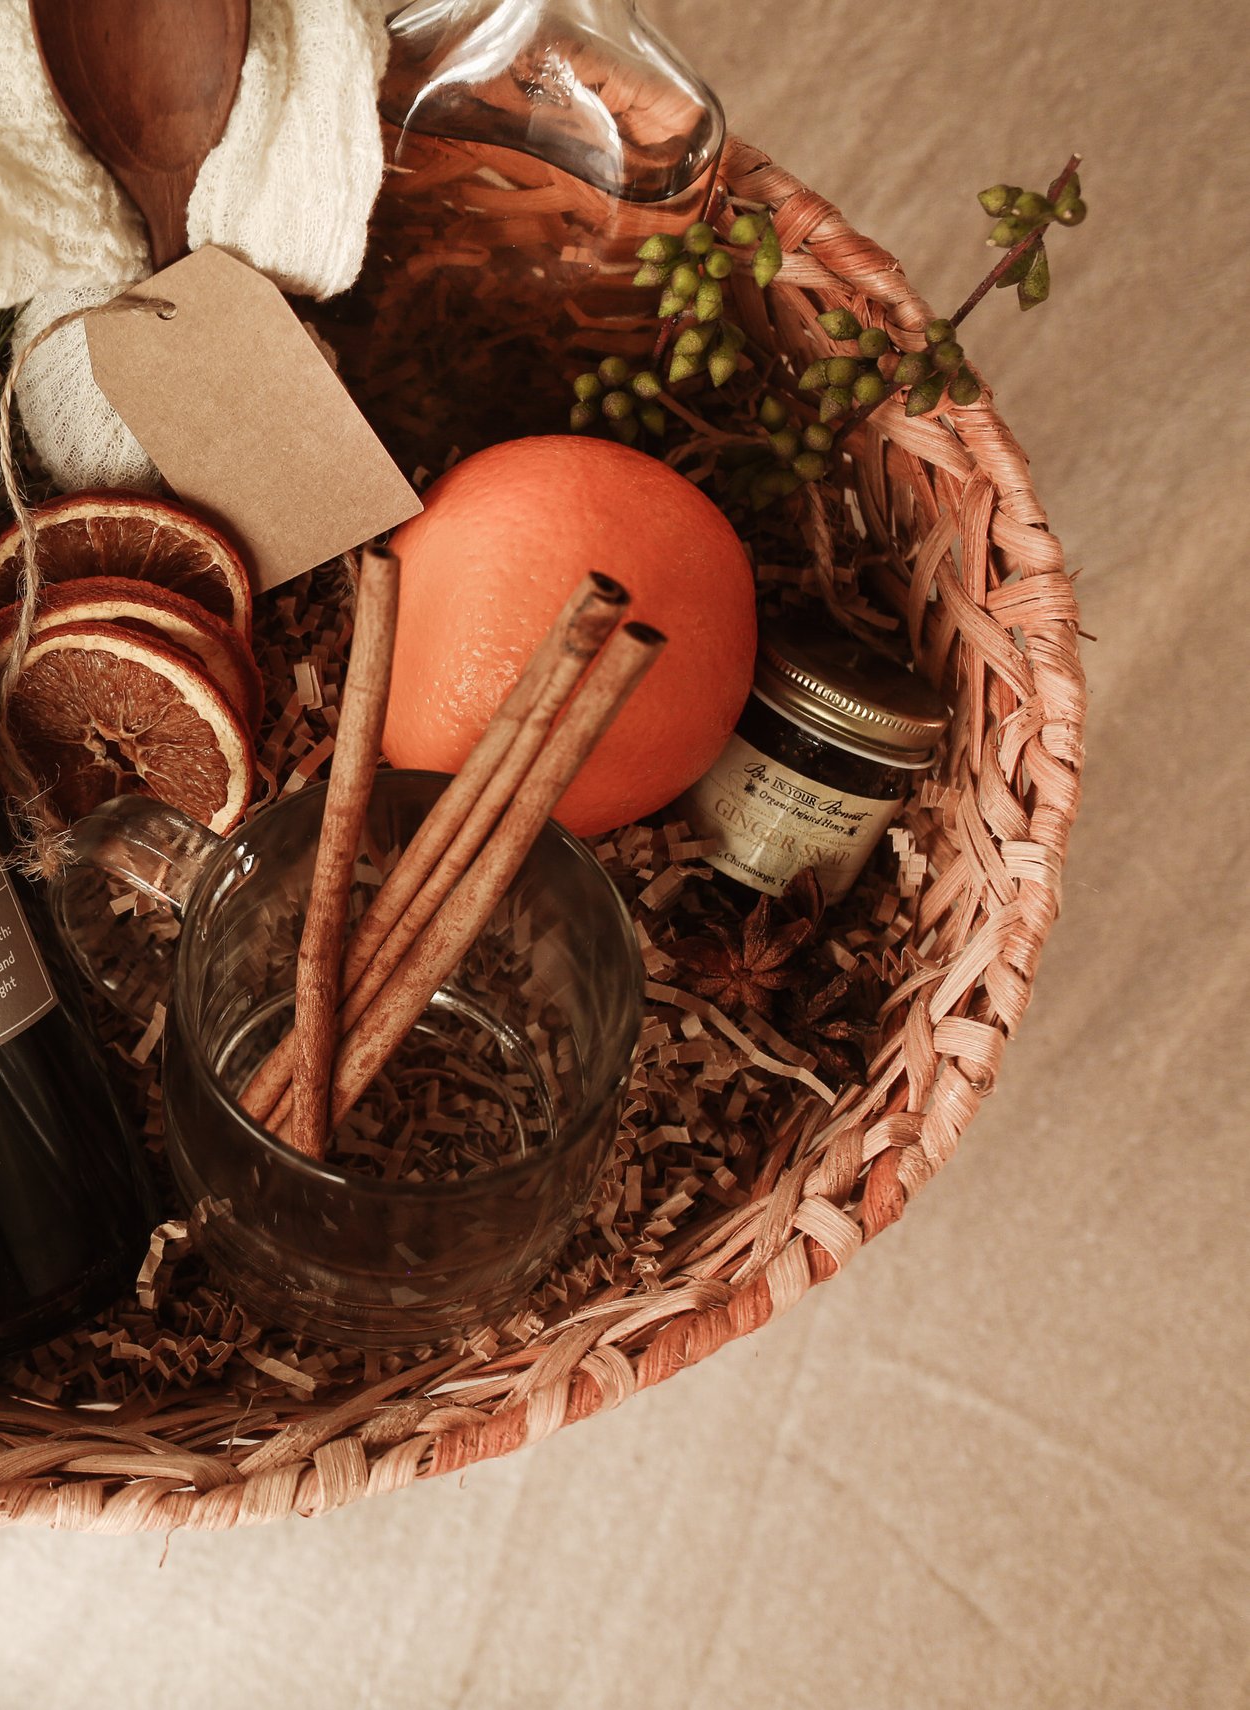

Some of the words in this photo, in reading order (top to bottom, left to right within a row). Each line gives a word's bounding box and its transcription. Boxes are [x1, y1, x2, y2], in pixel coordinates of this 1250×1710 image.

[759, 789, 791, 812] Organic
[791, 807, 820, 826] Infused
[772, 778, 786, 792] IN
[786, 786, 817, 807] YOUR
[715, 798, 796, 854] GINGER
[724, 850, 776, 885] Chattanooga,
